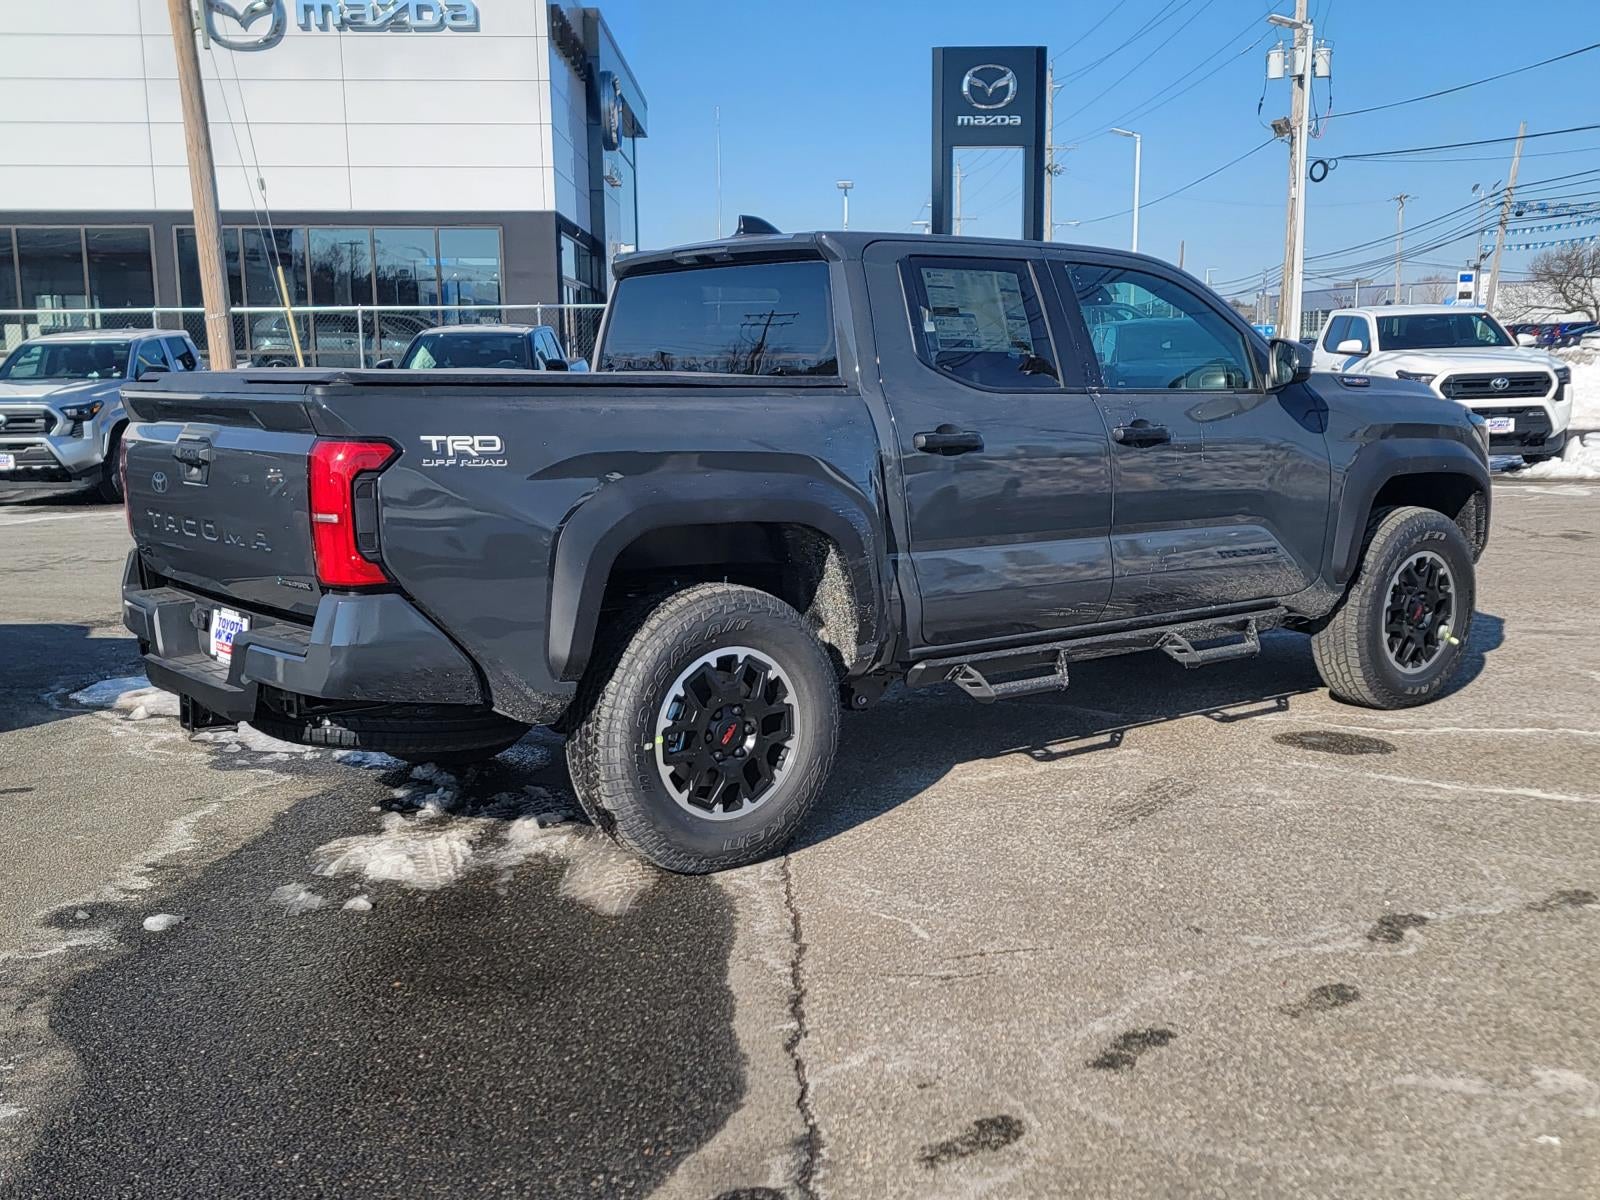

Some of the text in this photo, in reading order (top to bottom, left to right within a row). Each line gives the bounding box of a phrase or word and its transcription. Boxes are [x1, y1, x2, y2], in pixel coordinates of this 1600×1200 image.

[419, 435, 504, 457] TRD
[421, 458, 508, 467] OFF ROAD
[146, 509, 272, 552] TACOMA
[218, 616, 243, 634] TOYOTA
